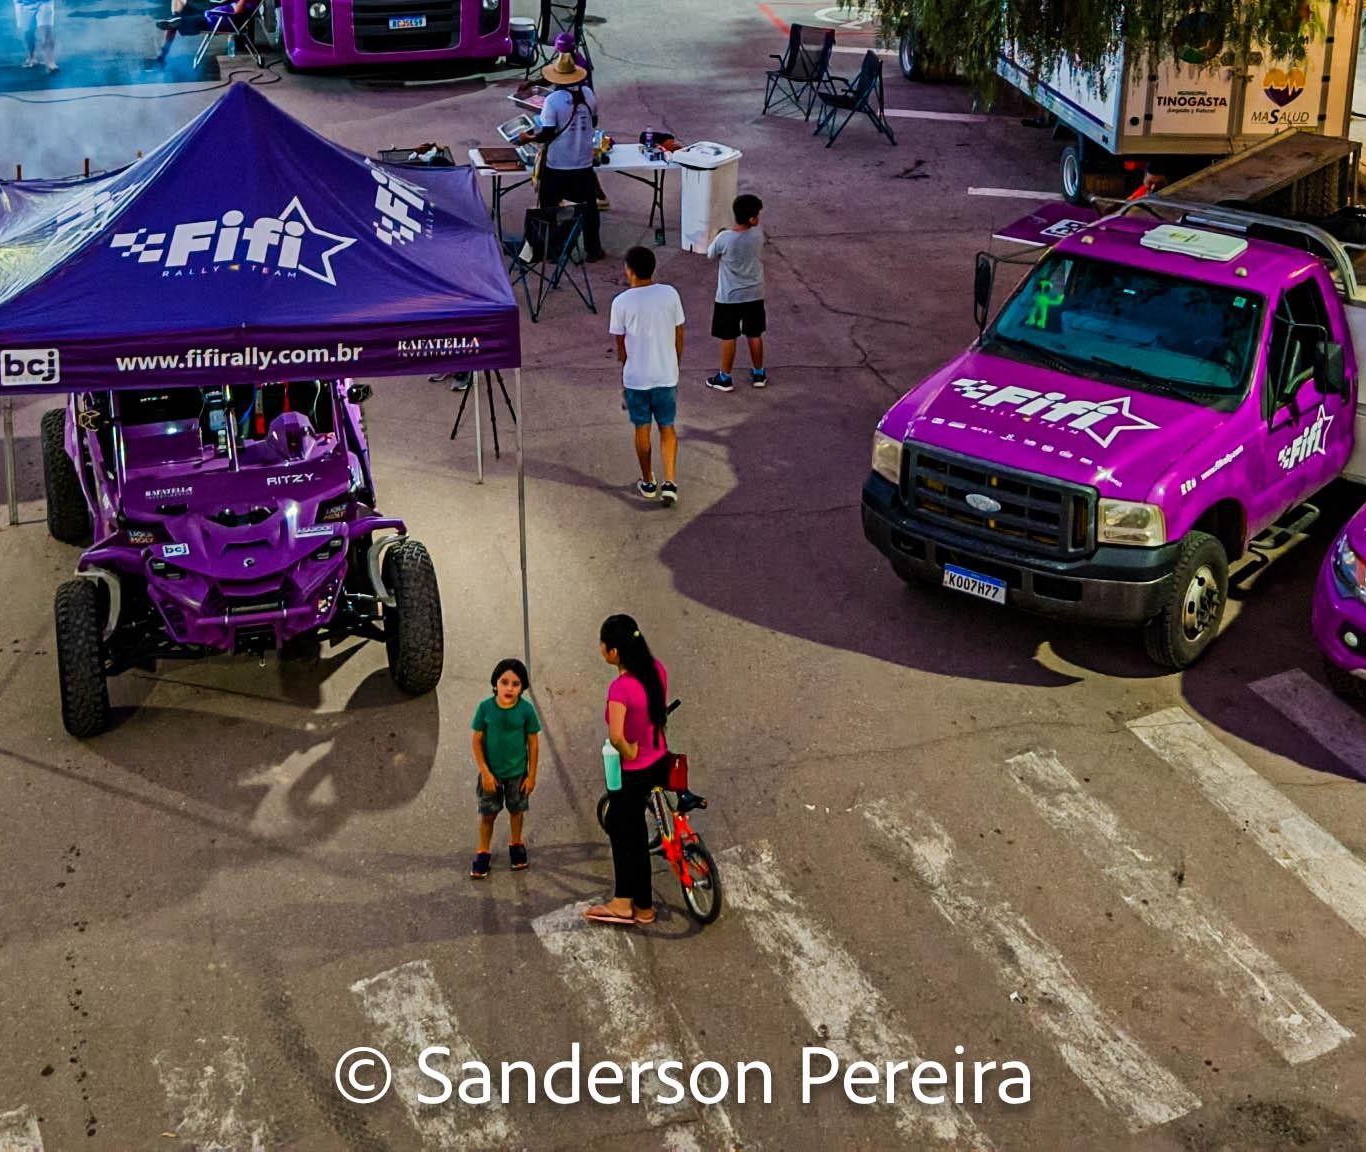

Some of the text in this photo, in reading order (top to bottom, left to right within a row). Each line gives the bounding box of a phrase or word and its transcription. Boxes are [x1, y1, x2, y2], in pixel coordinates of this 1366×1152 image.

[1157, 96, 1227, 107] TINOGASTA
[164, 209, 306, 269] Fifi
[161, 264, 298, 279] RALLY TEAM
[397, 336, 480, 351] RAFATELLA
[4, 350, 55, 382] bcj
[116, 343, 363, 372] www.fifirally.com.br
[977, 385, 1119, 430] Fifi
[1288, 417, 1323, 469] Fifi
[267, 473, 315, 486] RITZY
[165, 544, 188, 555] bcj
